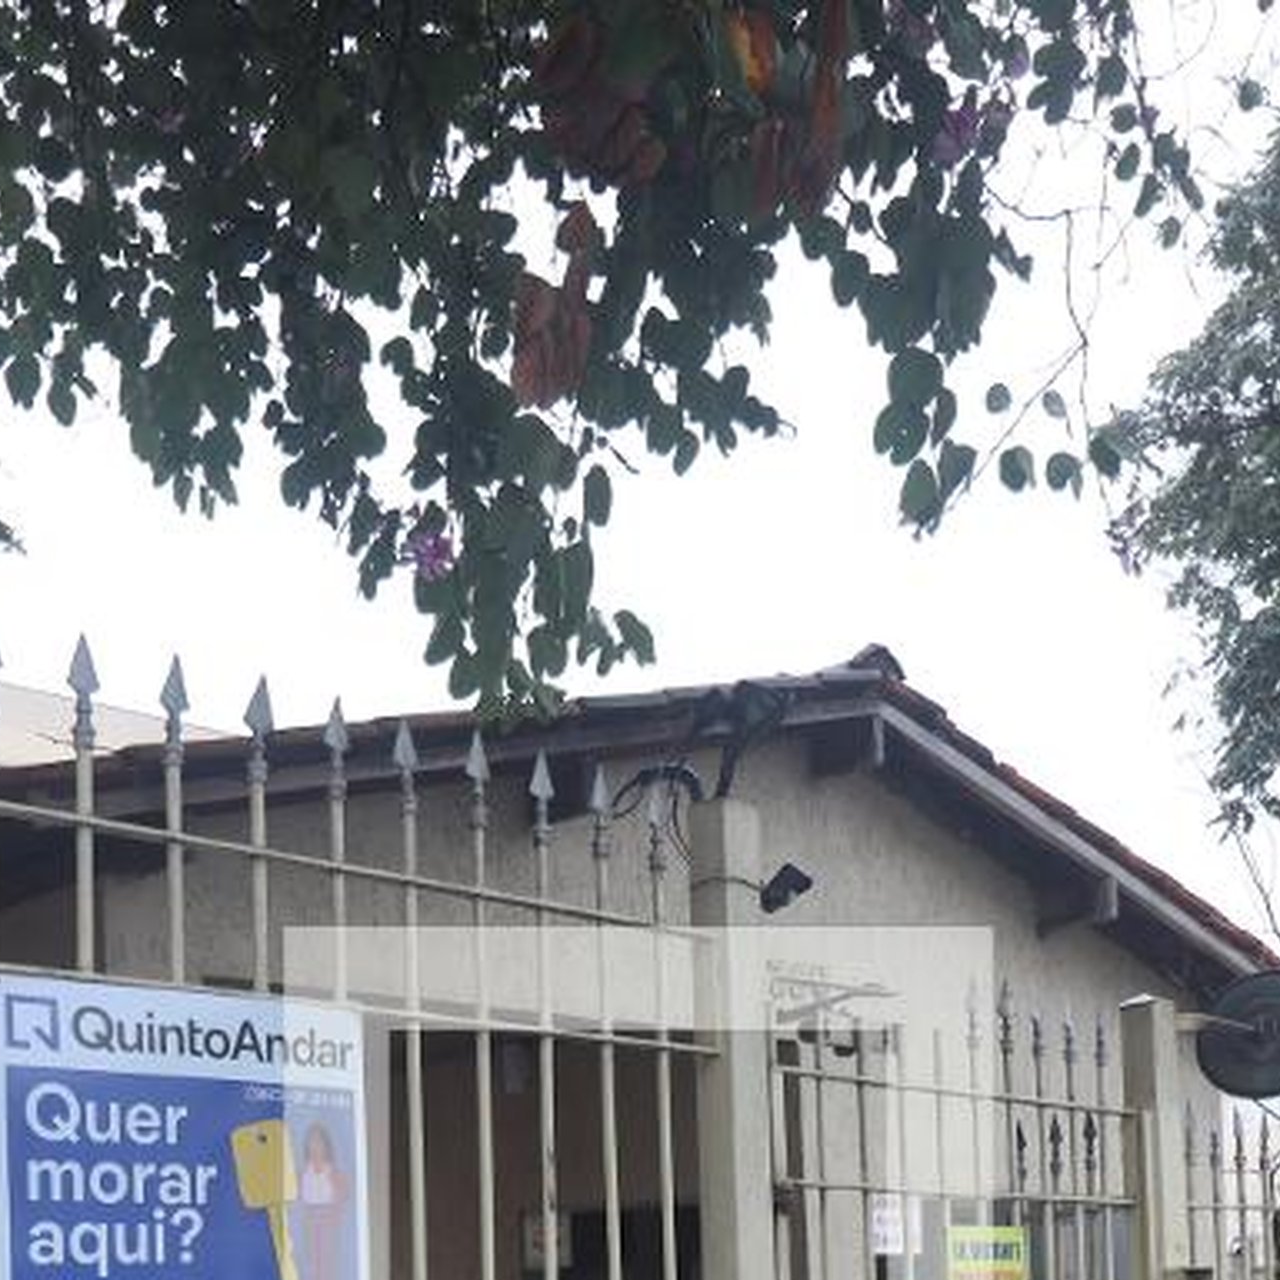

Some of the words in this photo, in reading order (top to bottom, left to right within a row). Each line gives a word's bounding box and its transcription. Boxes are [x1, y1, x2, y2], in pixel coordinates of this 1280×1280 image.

[72, 1006, 353, 1069] QuintoAndar
[26, 1082, 188, 1144] Quer
[26, 1159, 218, 1205] morar
[28, 1207, 204, 1278] aqui?
